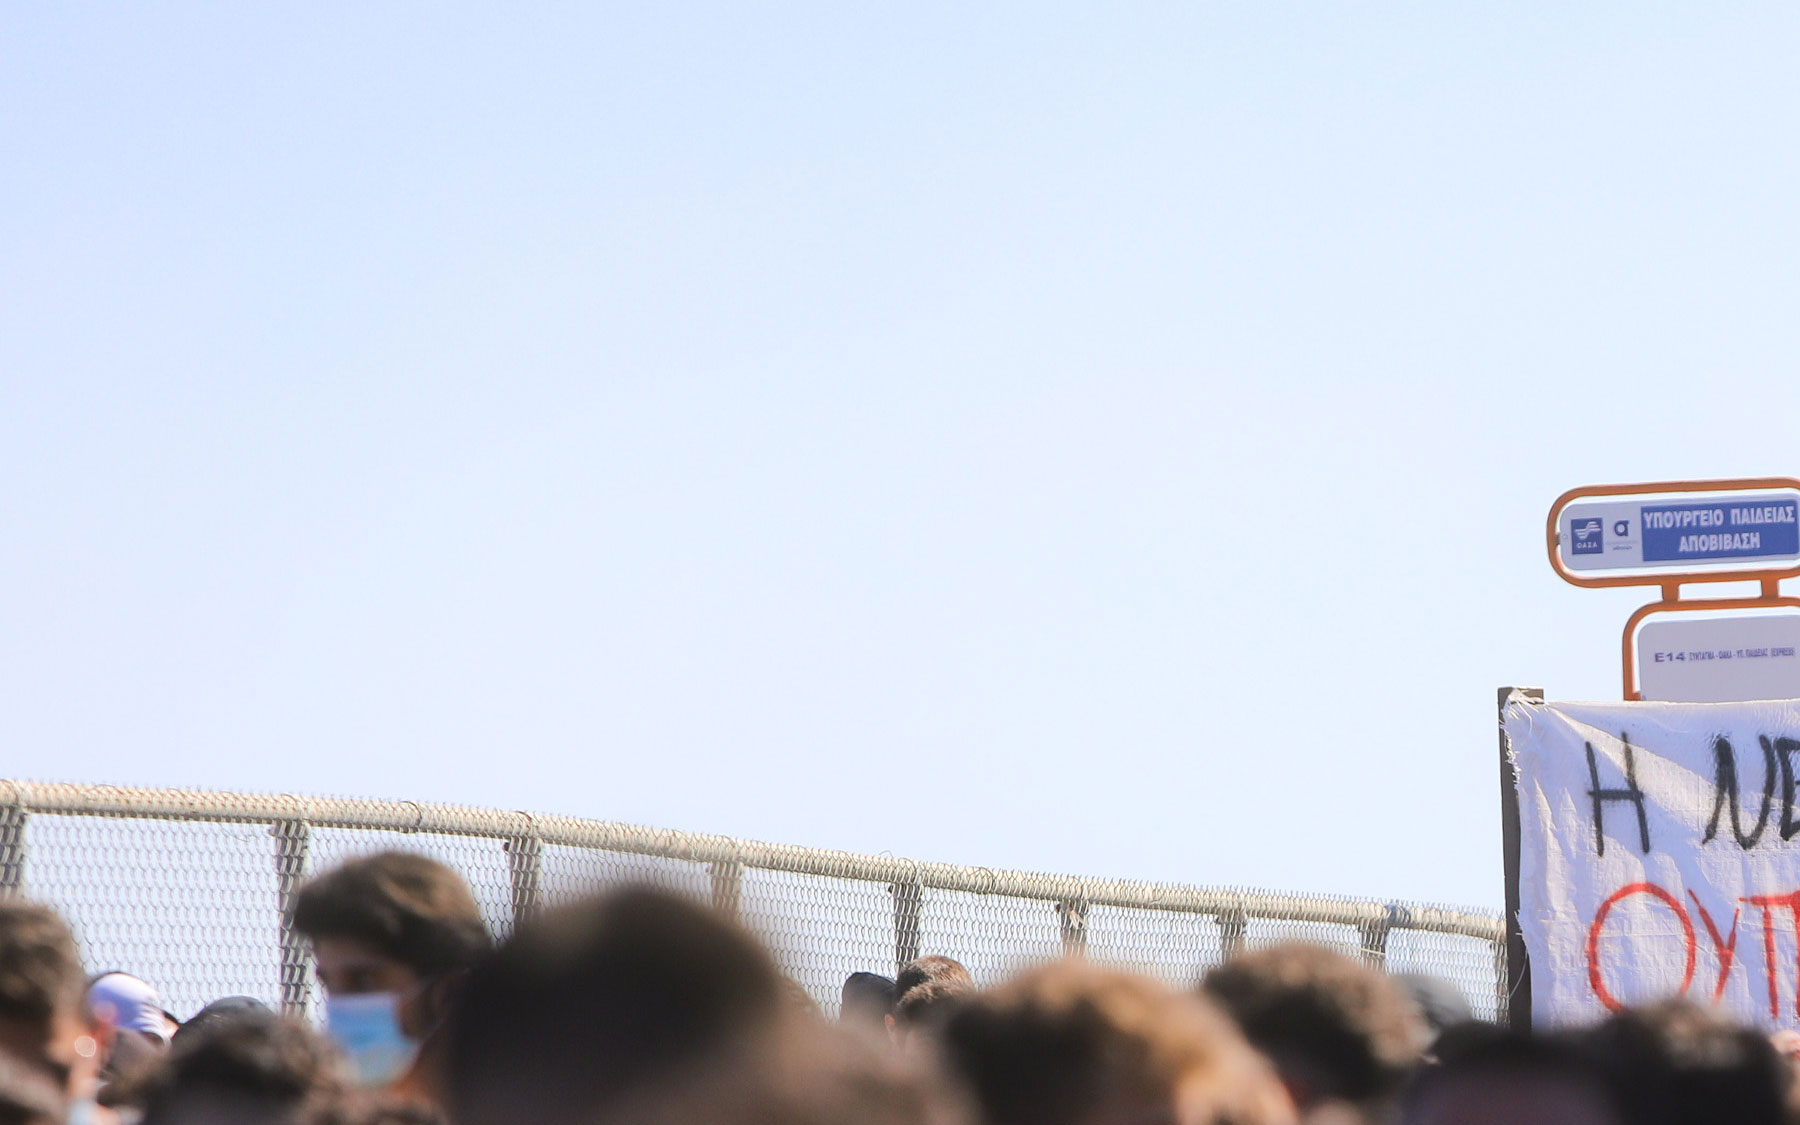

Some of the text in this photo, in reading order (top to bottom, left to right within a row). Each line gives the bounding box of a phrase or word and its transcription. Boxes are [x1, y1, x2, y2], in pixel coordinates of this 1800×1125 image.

[1643, 505, 1795, 529] ΥΠΟΥΡΓΕΙΟ ΠΑΙΔΕΙΑΣ
[1678, 532, 1761, 552] ΑΠΟΒΙΒΑΣΗ
[1585, 732, 1651, 857] Η
